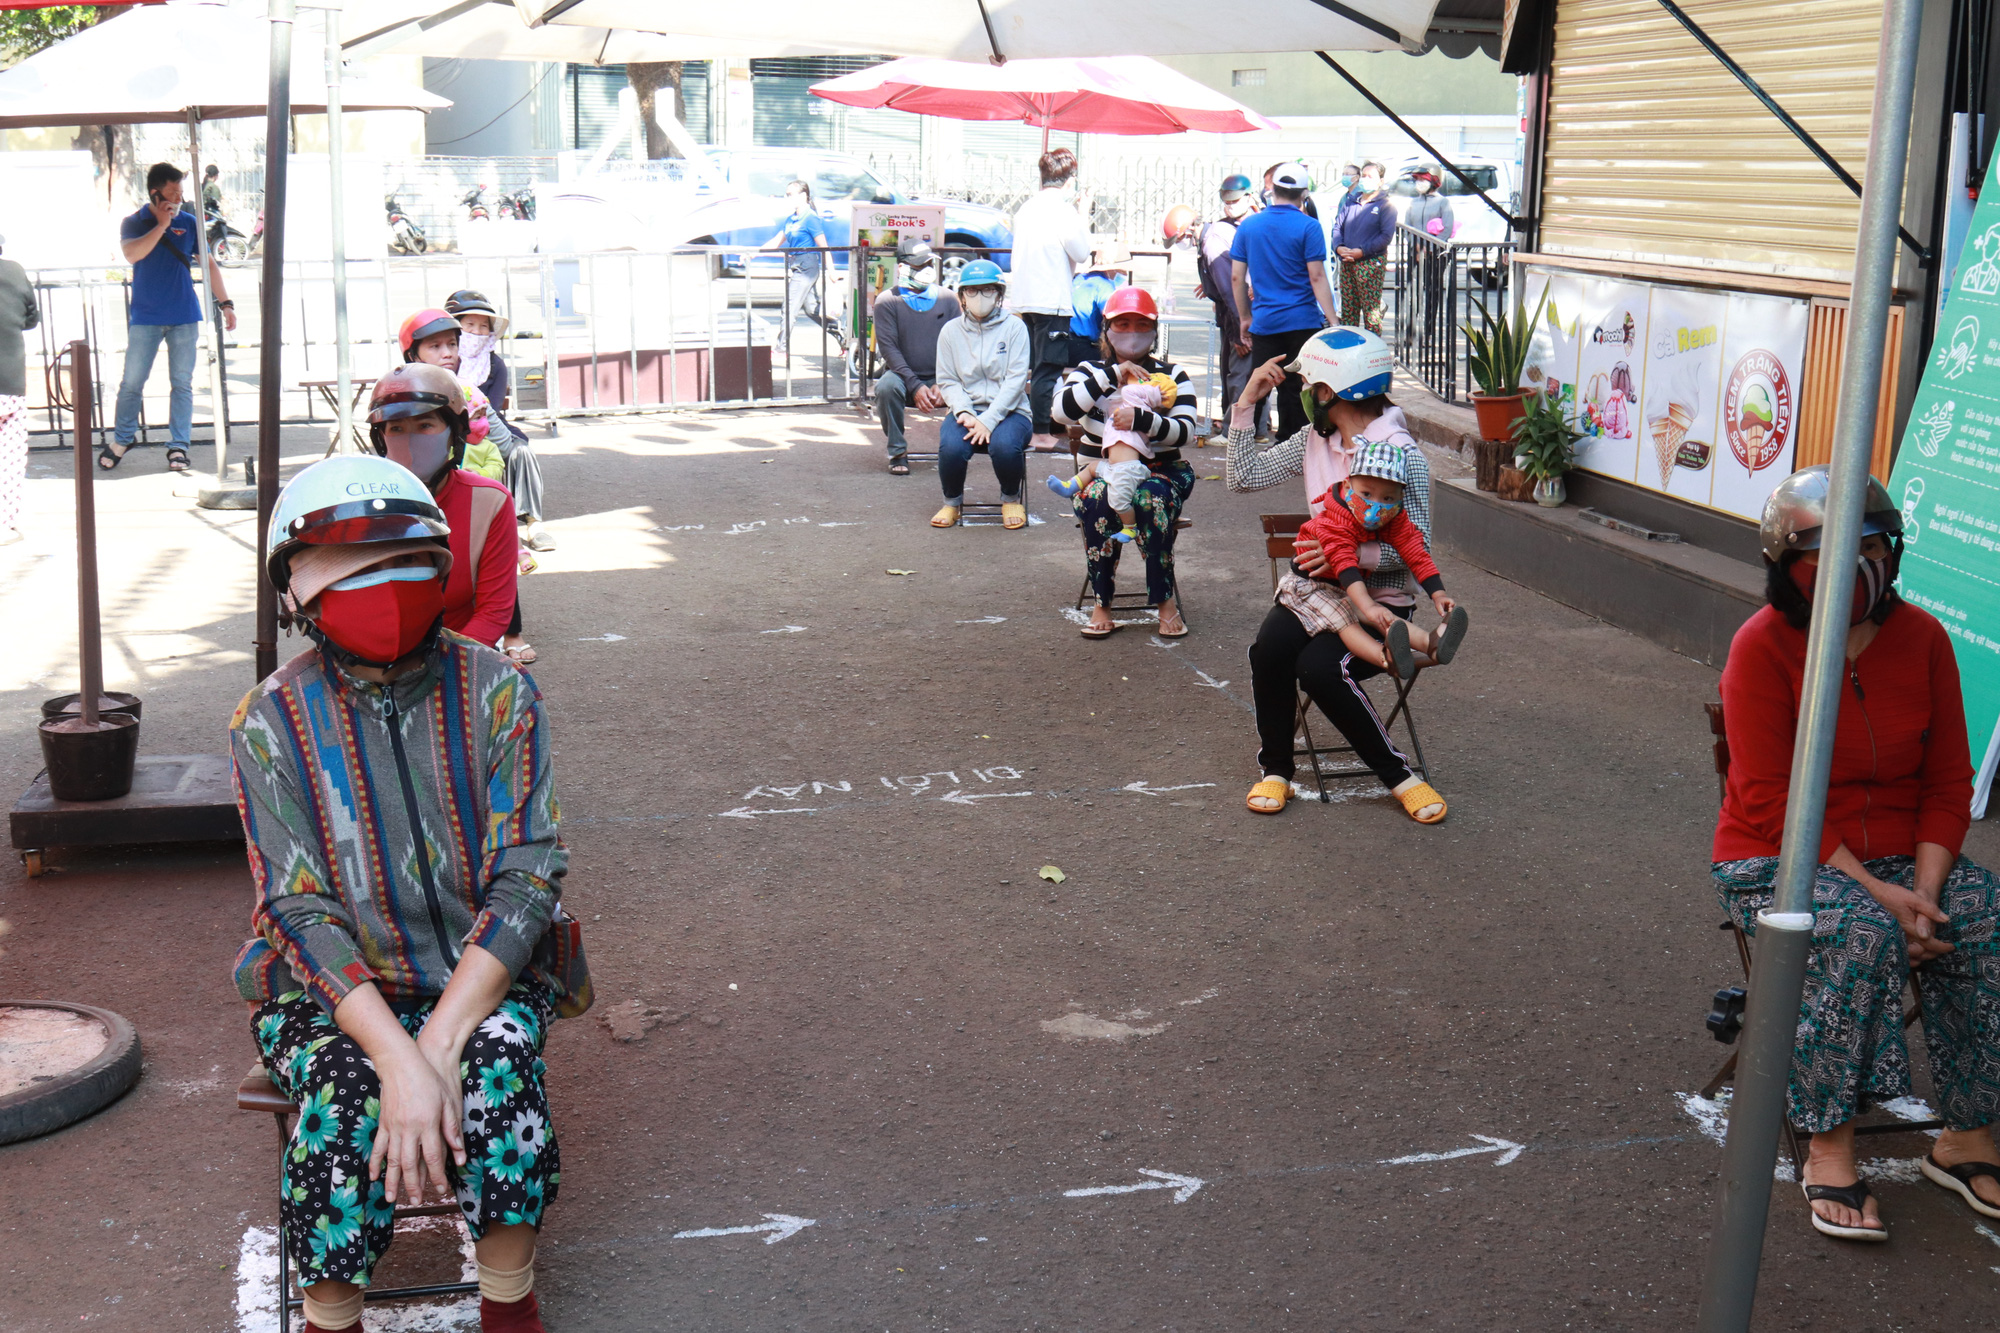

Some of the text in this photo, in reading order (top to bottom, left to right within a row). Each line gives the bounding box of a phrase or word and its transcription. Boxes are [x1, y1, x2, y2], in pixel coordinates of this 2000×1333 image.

[887, 218, 926, 228] Book'S
[1653, 324, 1718, 360] Cà Rem
[1727, 380, 1741, 422] KEM
[1739, 353, 1781, 383] TRÀNG
[1730, 431, 1778, 462] Since 1958
[1366, 456, 1400, 472] Devil
[346, 482, 400, 496] CLEAR
[1954, 528, 1969, 544] trang
[1968, 534, 1974, 544] y
